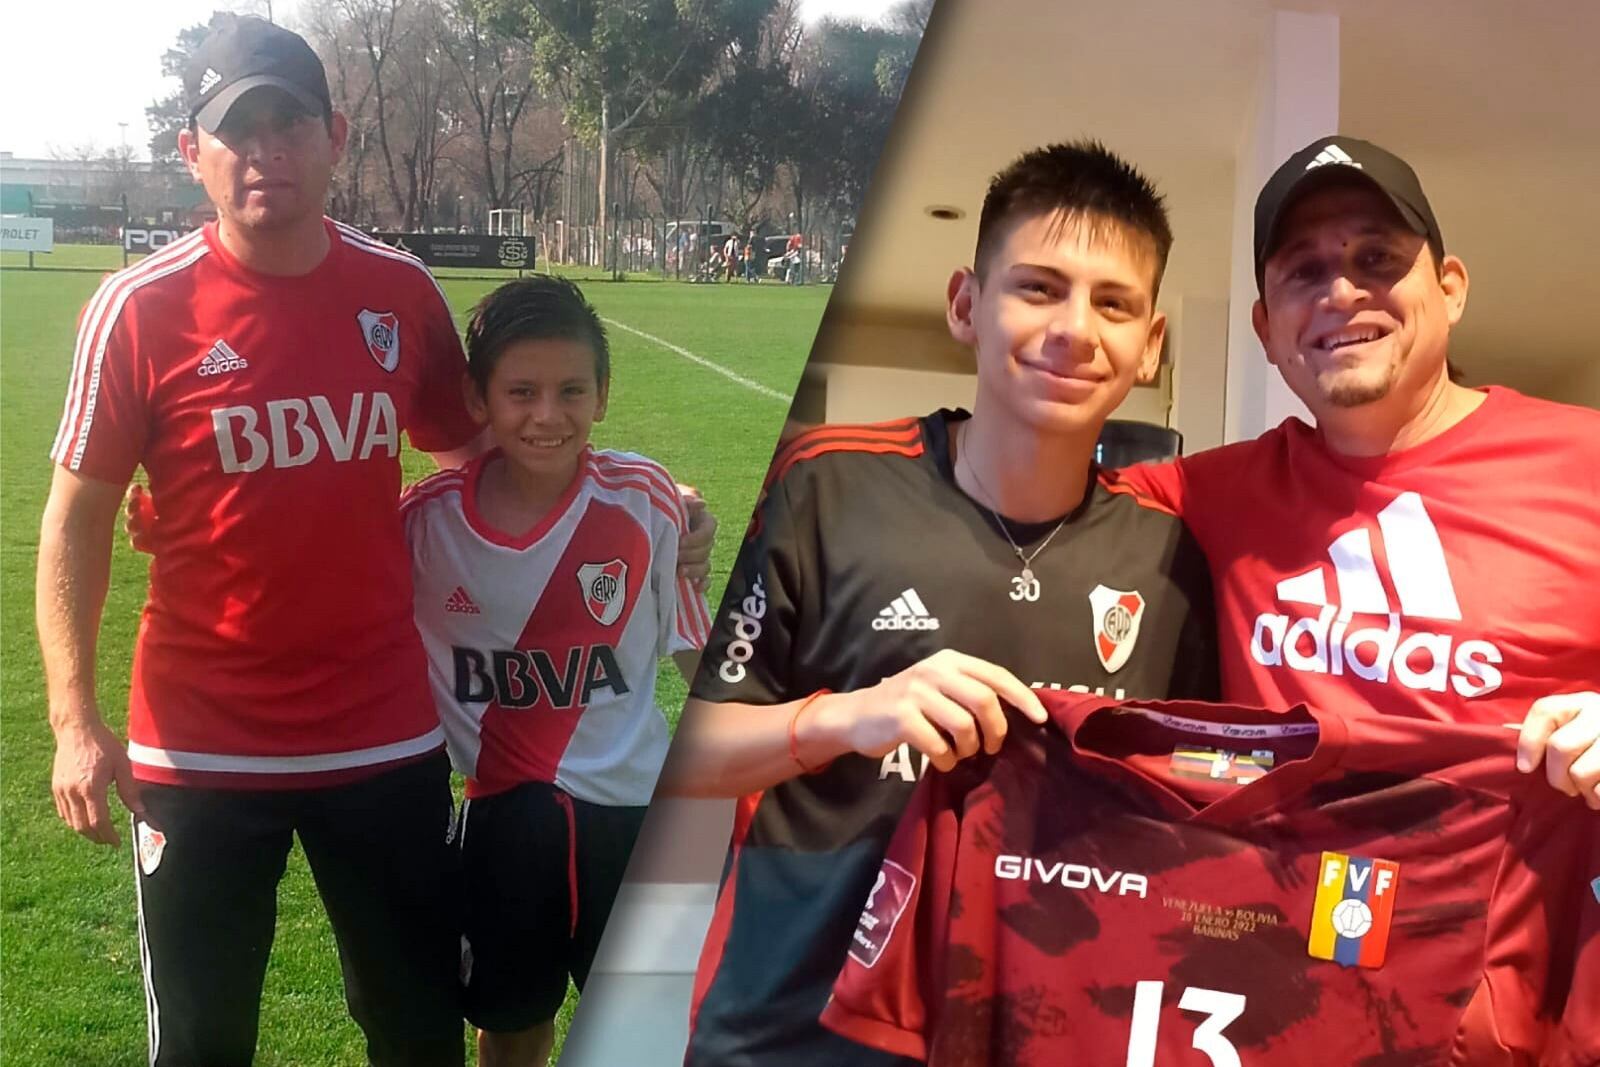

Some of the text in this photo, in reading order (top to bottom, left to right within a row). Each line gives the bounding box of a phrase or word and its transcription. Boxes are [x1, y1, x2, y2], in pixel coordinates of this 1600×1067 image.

[197, 358, 248, 377] adidas
[211, 392, 398, 473] BBVA
[1009, 576, 1041, 602] 30
[719, 573, 767, 683] coder
[871, 614, 941, 631] adidas
[1250, 604, 1503, 698] adidas
[453, 645, 630, 709] BBVA
[995, 854, 1148, 899] GIVOVA
[1323, 859, 1394, 896] FVF
[1195, 914, 1230, 928] ENERO
[1233, 919, 1256, 932] 2022
[1236, 909, 1279, 926] BOLIVIA
[1126, 980, 1247, 1067] 13
